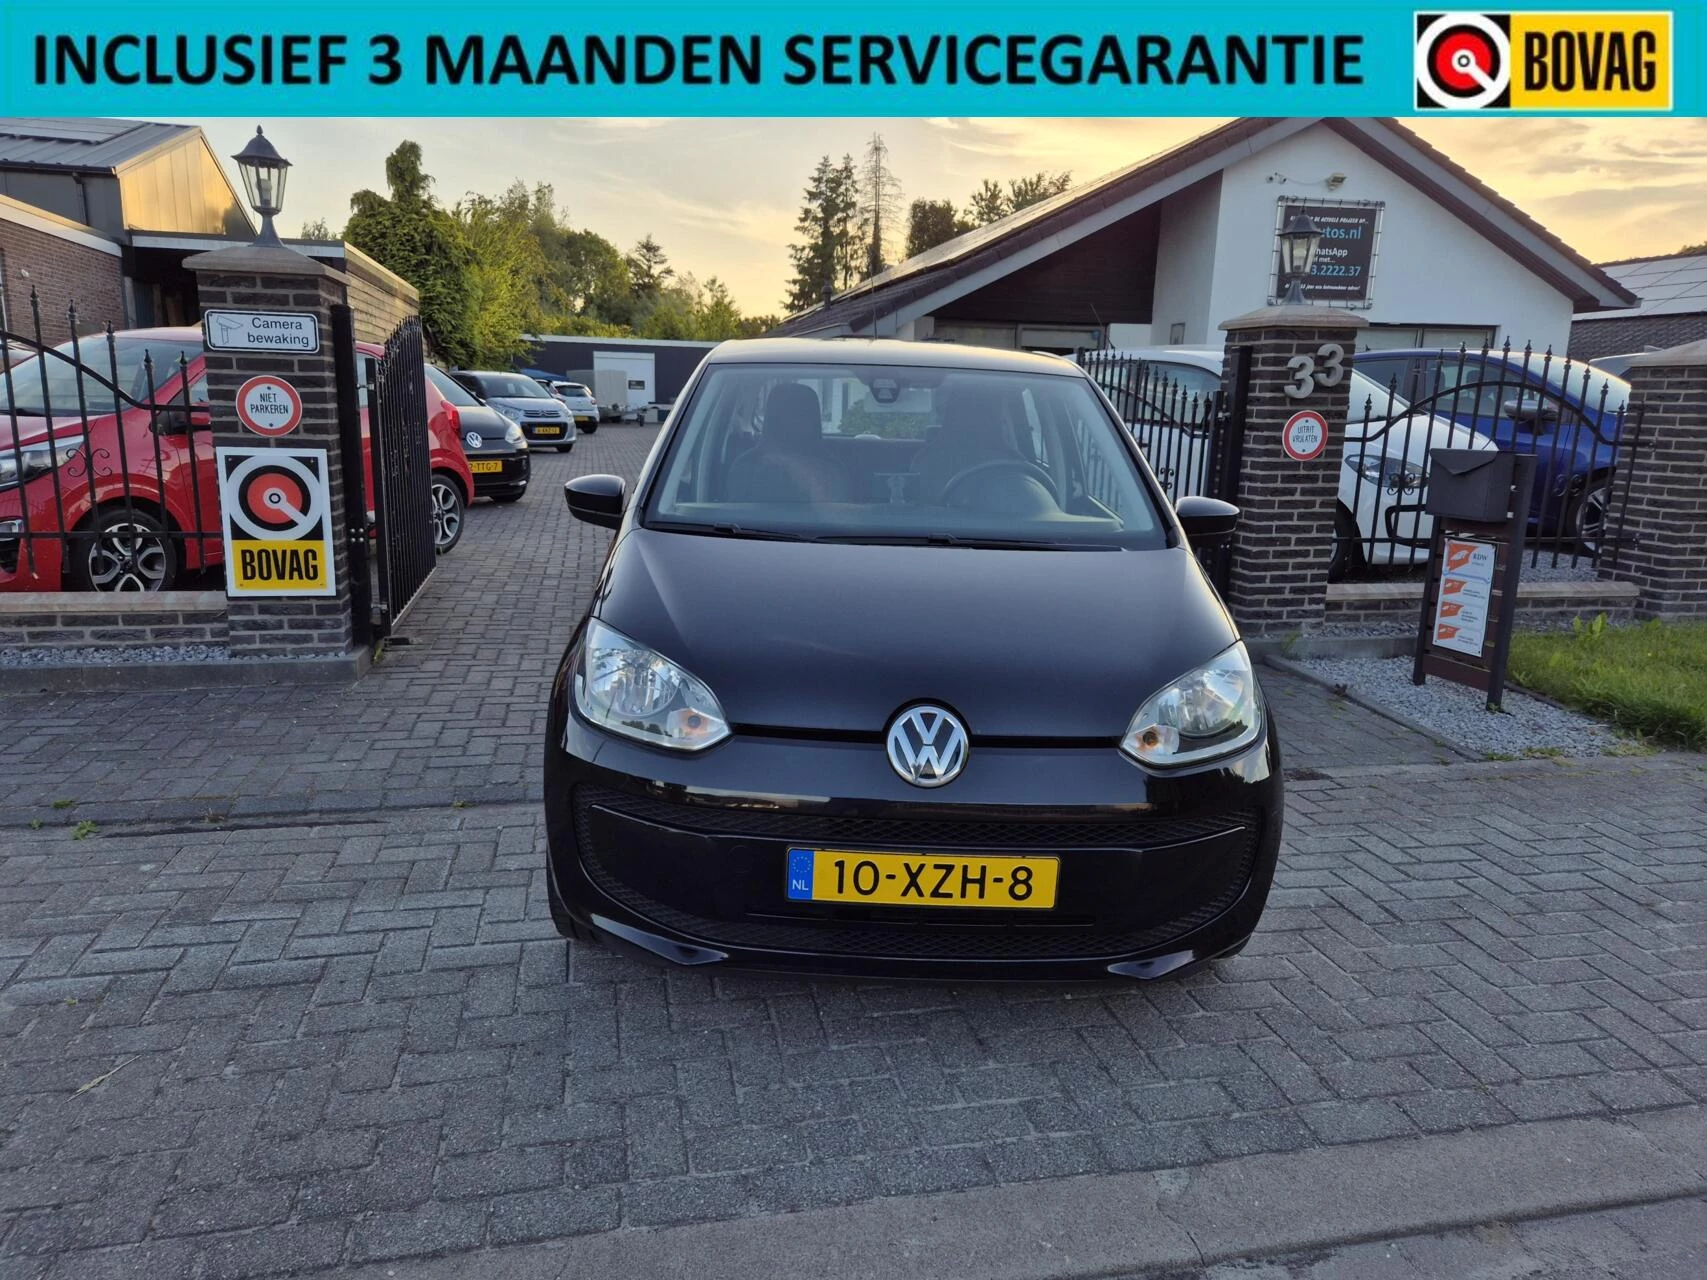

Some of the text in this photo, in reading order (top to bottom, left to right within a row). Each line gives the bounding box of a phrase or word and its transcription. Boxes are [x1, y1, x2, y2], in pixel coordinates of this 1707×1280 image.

[251, 317, 303, 330] Camera
[247, 332, 309, 348] bewaking
[1284, 344, 1344, 399] 33
[260, 393, 277, 403] NIET
[250, 404, 289, 415] PARKEREN
[1297, 425, 1315, 434] UITRIT
[240, 548, 319, 581] BOVAG
[792, 879, 809, 891] NL
[833, 859, 1034, 901] 10-XZH-8
